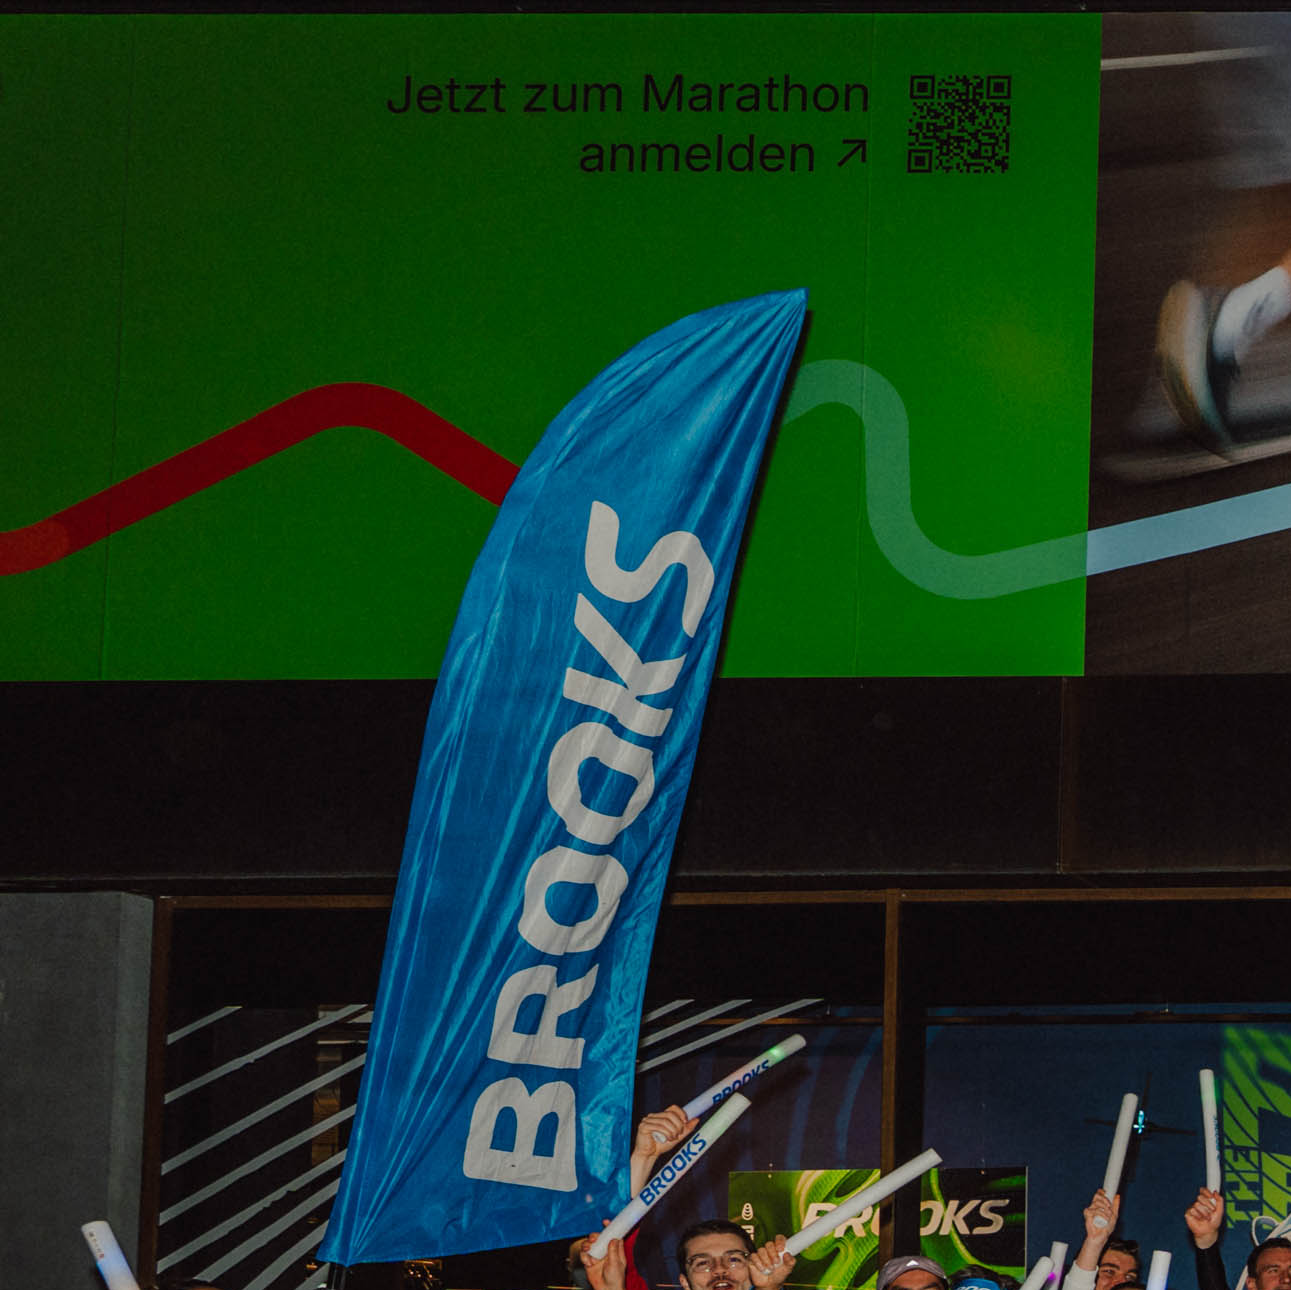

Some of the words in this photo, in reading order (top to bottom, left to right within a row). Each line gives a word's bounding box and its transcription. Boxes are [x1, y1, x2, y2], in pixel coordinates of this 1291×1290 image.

[387, 75, 507, 114] Jetzt
[524, 84, 623, 114] zum
[643, 73, 870, 114] Marathon
[579, 134, 815, 173] anmelden
[463, 501, 715, 1192] BROOKS
[639, 1133, 707, 1207] BROOKS
